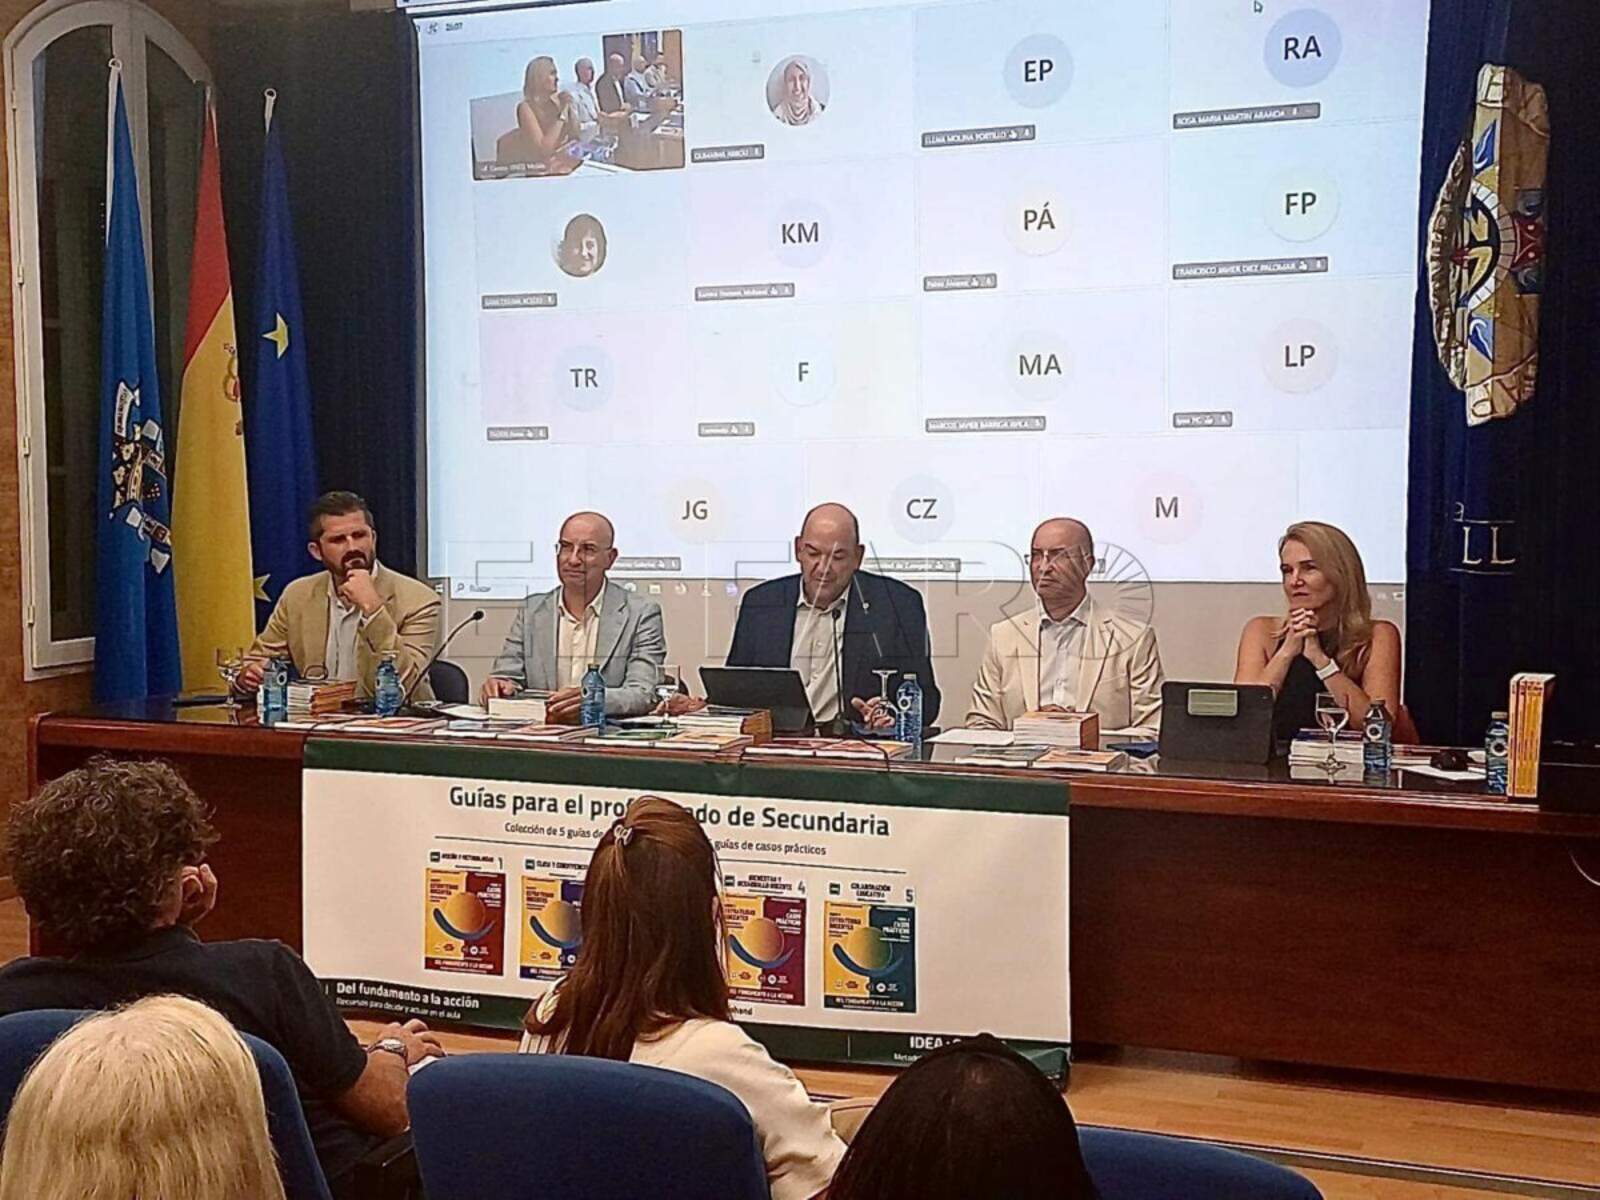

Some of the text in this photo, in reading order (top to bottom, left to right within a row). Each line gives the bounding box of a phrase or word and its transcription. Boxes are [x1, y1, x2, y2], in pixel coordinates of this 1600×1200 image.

[1284, 35, 1322, 60] RA
[1024, 60, 1053, 83] EP
[1285, 191, 1317, 215] FP
[1023, 202, 1056, 231] PÁ
[782, 222, 819, 244] KM
[1019, 354, 1062, 376] MA
[1284, 344, 1316, 367] LP
[570, 368, 599, 388] TR
[798, 362, 809, 382] F
[681, 500, 708, 520] JG
[906, 498, 938, 519] CZ
[1155, 497, 1179, 518] M
[450, 786, 506, 809] Guías
[512, 794, 558, 816] para
[565, 794, 583, 814] el
[728, 805, 754, 826] de
[762, 807, 890, 836] Secundaria
[505, 822, 545, 835] Colección
[546, 824, 557, 836] de
[559, 826, 565, 836] 5
[567, 826, 591, 840] guías
[714, 839, 826, 855] guías de casos prácticos
[798, 880, 806, 894] 4
[906, 889, 913, 902] 5
[337, 982, 480, 1008] Del fundamento a la acción
[910, 1036, 943, 1049] IDEA
